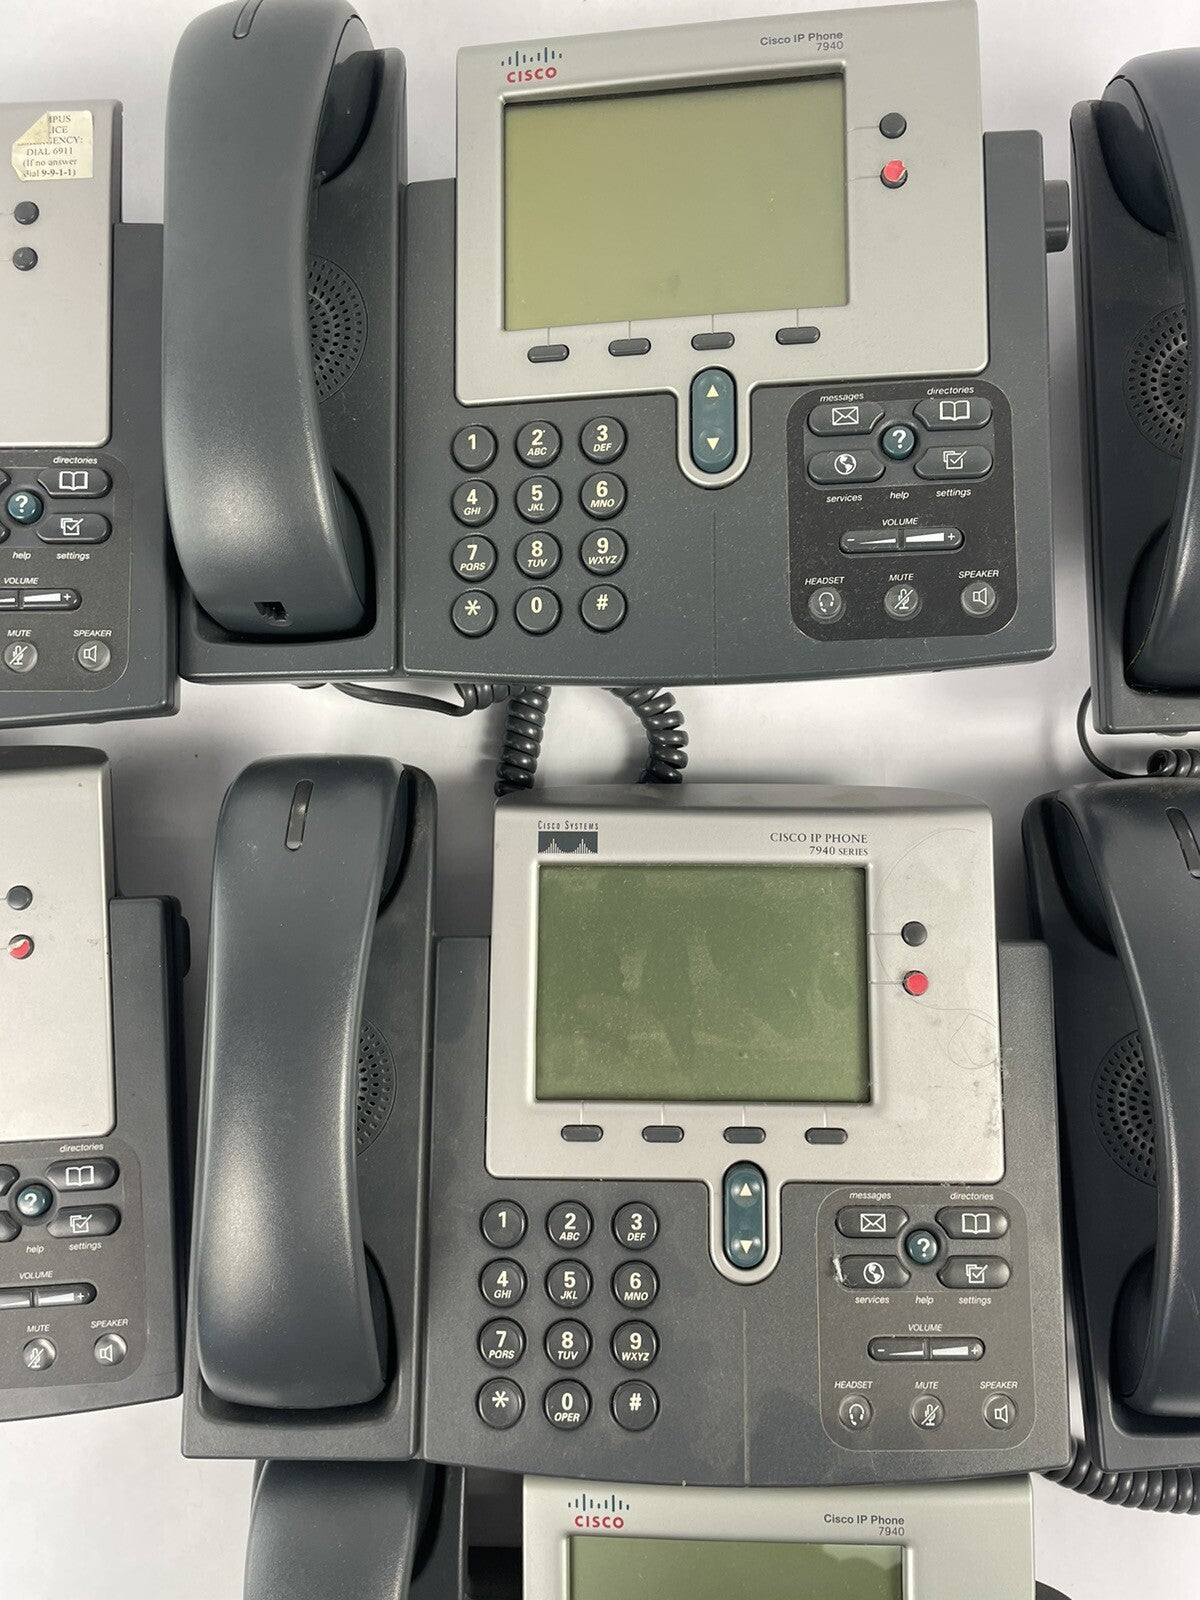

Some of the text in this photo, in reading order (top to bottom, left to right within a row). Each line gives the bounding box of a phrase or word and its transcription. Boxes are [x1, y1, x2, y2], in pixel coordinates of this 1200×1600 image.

[760, 32, 843, 46] Cisco IP Phone
[816, 41, 844, 51] 7940
[506, 66, 557, 83] CISCO
[26, 147, 73, 156] DIAL 6911
[41, 168, 76, 176] 9-9-1-1)
[927, 386, 974, 396] directories
[819, 392, 864, 402] messages
[531, 429, 543, 446] 2
[597, 425, 609, 441] 3
[468, 434, 476, 450] 1
[527, 447, 547, 456] ABC
[593, 443, 613, 452] DEF
[53, 456, 98, 465] directories
[531, 484, 543, 501] 5
[596, 480, 609, 498] 6
[936, 489, 972, 498] settings
[466, 489, 478, 505] 4
[826, 493, 863, 503] services
[890, 491, 909, 500] help
[527, 503, 545, 512] JKL
[590, 499, 615, 507] MNO
[463, 507, 481, 516] GHI
[882, 517, 919, 526] VOLUME
[531, 540, 543, 557] 8
[597, 537, 609, 554] 9
[12, 551, 32, 560] help
[56, 552, 90, 561] settings
[467, 544, 478, 561] 7
[527, 559, 548, 568] TUV
[588, 555, 618, 565] WXYZ
[459, 562, 486, 571] PQRS
[888, 573, 914, 581] MUTE
[958, 569, 999, 579] SPEAKER
[3, 577, 39, 585] VOLUME
[804, 576, 845, 586] HEADSET
[531, 597, 542, 613] 0
[7, 629, 32, 637] MUTE
[73, 629, 112, 637] SPEAKER
[770, 832, 868, 843] CISCO IP PHONE
[809, 846, 868, 856] 7940 SERIES
[59, 1143, 104, 1153] directories
[849, 1192, 892, 1200] messages
[950, 1192, 994, 1200] directories
[499, 1211, 507, 1228] 1
[564, 1212, 577, 1230] 2
[631, 1213, 643, 1230] 3
[559, 1232, 580, 1241] ABC
[627, 1232, 647, 1242] DEF
[26, 1245, 45, 1254] help
[69, 1241, 102, 1251] settings
[19, 1271, 54, 1280] VOLUME
[496, 1270, 509, 1287] 4
[564, 1271, 576, 1288] 5
[629, 1272, 642, 1289] 6
[493, 1289, 512, 1299] GHI
[560, 1290, 578, 1300] JKL
[624, 1292, 649, 1301] MNO
[855, 1296, 890, 1304] services
[915, 1295, 934, 1304] help
[958, 1296, 992, 1305] settings
[26, 1324, 50, 1332] MUTE
[91, 1318, 129, 1328] SPEAKER
[908, 1324, 943, 1332] VOLUME
[495, 1330, 508, 1348] 7
[561, 1331, 574, 1349] 8
[629, 1332, 642, 1350] 9
[488, 1350, 515, 1359] PQRS
[558, 1350, 579, 1360] TUV
[621, 1352, 650, 1362] WXYZ
[834, 1381, 873, 1389] HEADSET
[980, 1381, 1018, 1389] SPEAKER
[561, 1393, 574, 1411] 0
[554, 1413, 581, 1422] OPER
[574, 1515, 624, 1529] CISCO
[824, 1514, 904, 1525] Cisco IP Phone
[879, 1527, 905, 1536] 7940
